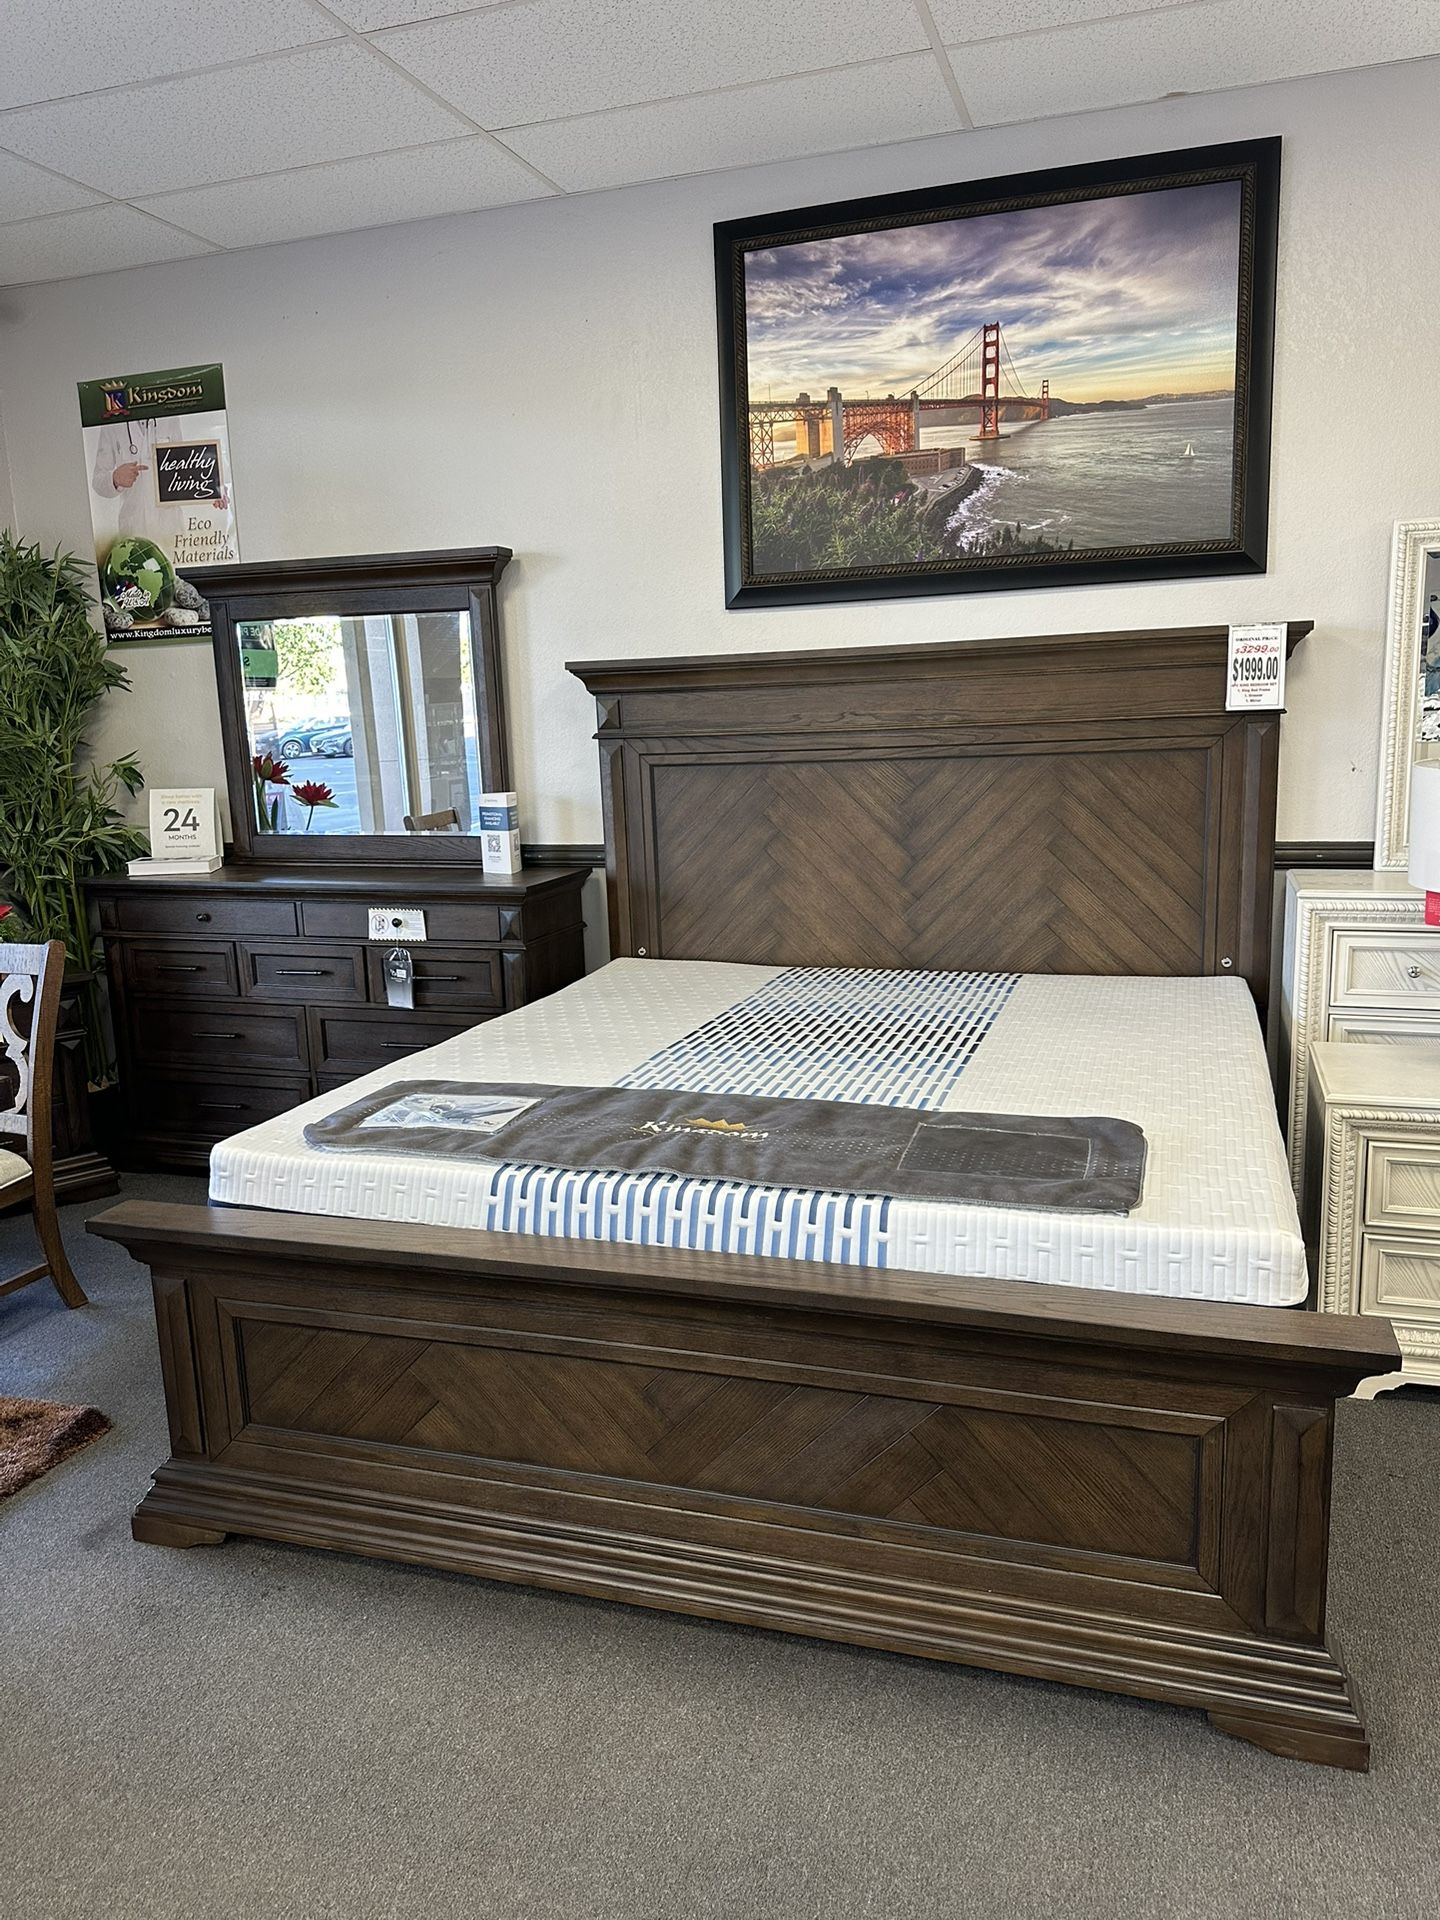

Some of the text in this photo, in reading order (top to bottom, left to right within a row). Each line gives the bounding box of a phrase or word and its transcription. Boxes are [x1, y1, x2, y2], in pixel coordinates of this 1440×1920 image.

[128, 385, 203, 404] Kingdom
[160, 447, 216, 479] healthy
[168, 472, 214, 499] living
[188, 517, 212, 531] Eco
[174, 530, 230, 548] Friendly
[173, 546, 235, 564] Materials
[1235, 644, 1280, 655] $3299.00
[1232, 656, 1279, 681] $1999.00
[163, 808, 200, 832] 24
